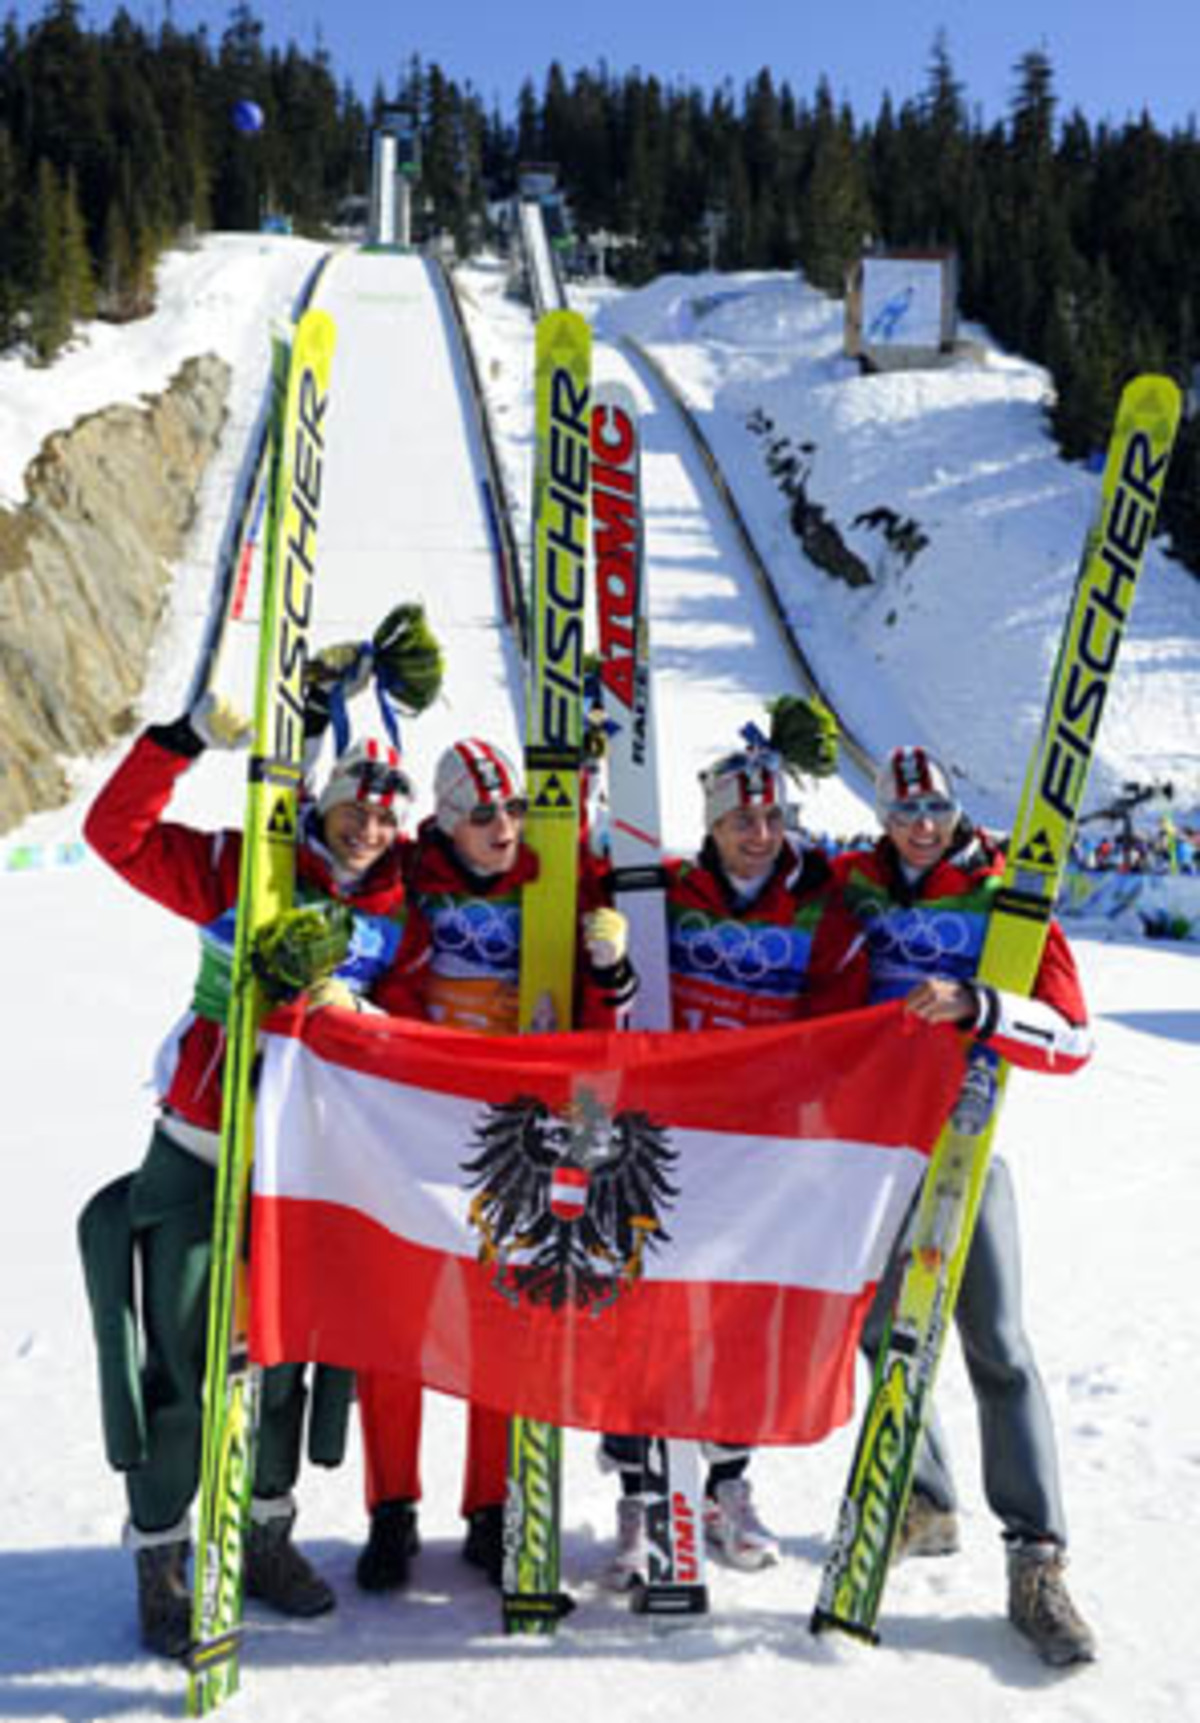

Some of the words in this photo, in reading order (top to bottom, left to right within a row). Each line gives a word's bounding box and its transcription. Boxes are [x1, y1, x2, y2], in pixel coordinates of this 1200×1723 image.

[276, 369, 327, 761] FISCHER
[544, 367, 590, 749] FISCHER
[590, 403, 635, 710] ATOMIC
[1040, 430, 1167, 821] FISCHER
[671, 1491, 698, 1583] UMP
